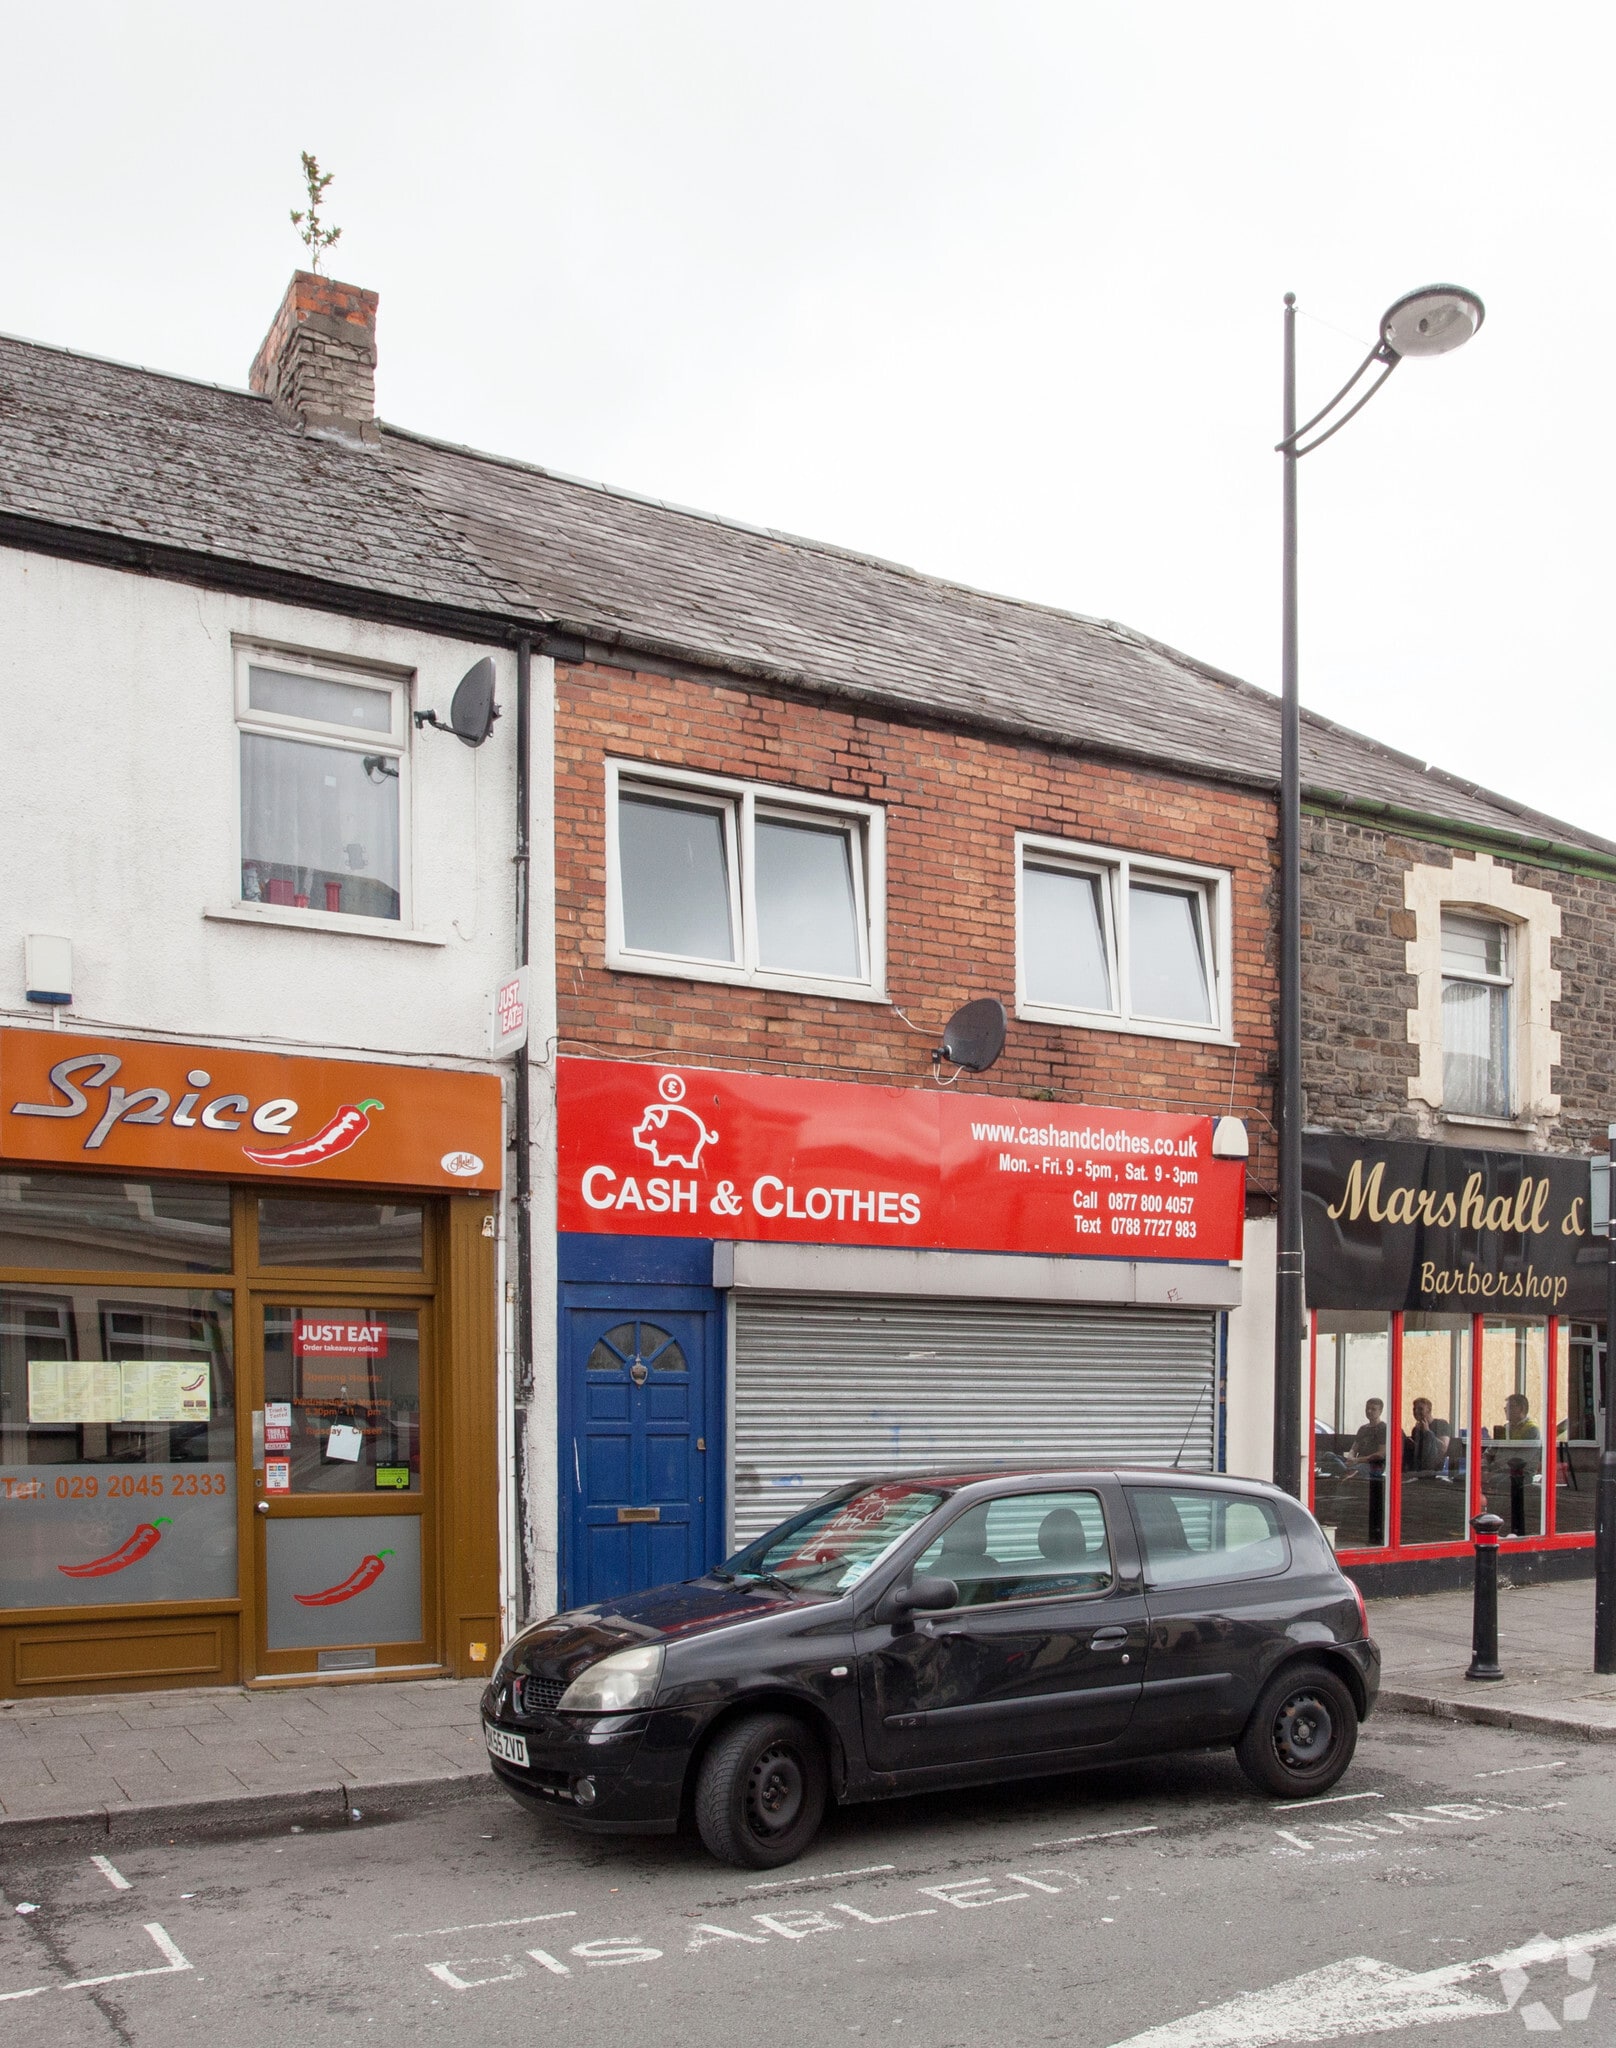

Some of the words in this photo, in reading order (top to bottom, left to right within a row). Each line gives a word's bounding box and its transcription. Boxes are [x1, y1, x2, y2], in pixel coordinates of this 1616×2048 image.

[499, 982, 519, 1012] JUST
[502, 1004, 518, 1032] EAT
[12, 1053, 299, 1149] Spice
[971, 1122, 1198, 1158] www.cashandclothes.co.uk
[999, 1154, 1030, 1174] Mon.
[1042, 1157, 1063, 1175] Fri.
[1066, 1161, 1074, 1176] 9
[1125, 1163, 1149, 1181] Sat.
[1155, 1167, 1162, 1182] 9
[1173, 1166, 1198, 1187] 3pm
[581, 1165, 698, 1214] CASH
[709, 1180, 743, 1216] &
[752, 1175, 921, 1225] CLOTHES
[1073, 1190, 1098, 1209] Call
[1108, 1193, 1137, 1211] 0877
[1140, 1194, 1162, 1212] 800
[1165, 1197, 1194, 1214] 4057
[1327, 1159, 1550, 1234] Marshall
[1561, 1197, 1585, 1236] &
[1074, 1215, 1101, 1233] Text
[1111, 1216, 1140, 1235] 0788
[1143, 1218, 1172, 1237] 7727
[1175, 1220, 1197, 1238] 983
[1420, 1261, 1568, 1306] Barbershop
[298, 1325, 345, 1342] JUST
[347, 1326, 382, 1342] EAT
[324, 1344, 356, 1353] takeaway
[55, 1476, 98, 1499] 029
[107, 1475, 164, 1498] 2045
[172, 1473, 226, 1496] 2333
[424, 1868, 1090, 1990] DISABLED
